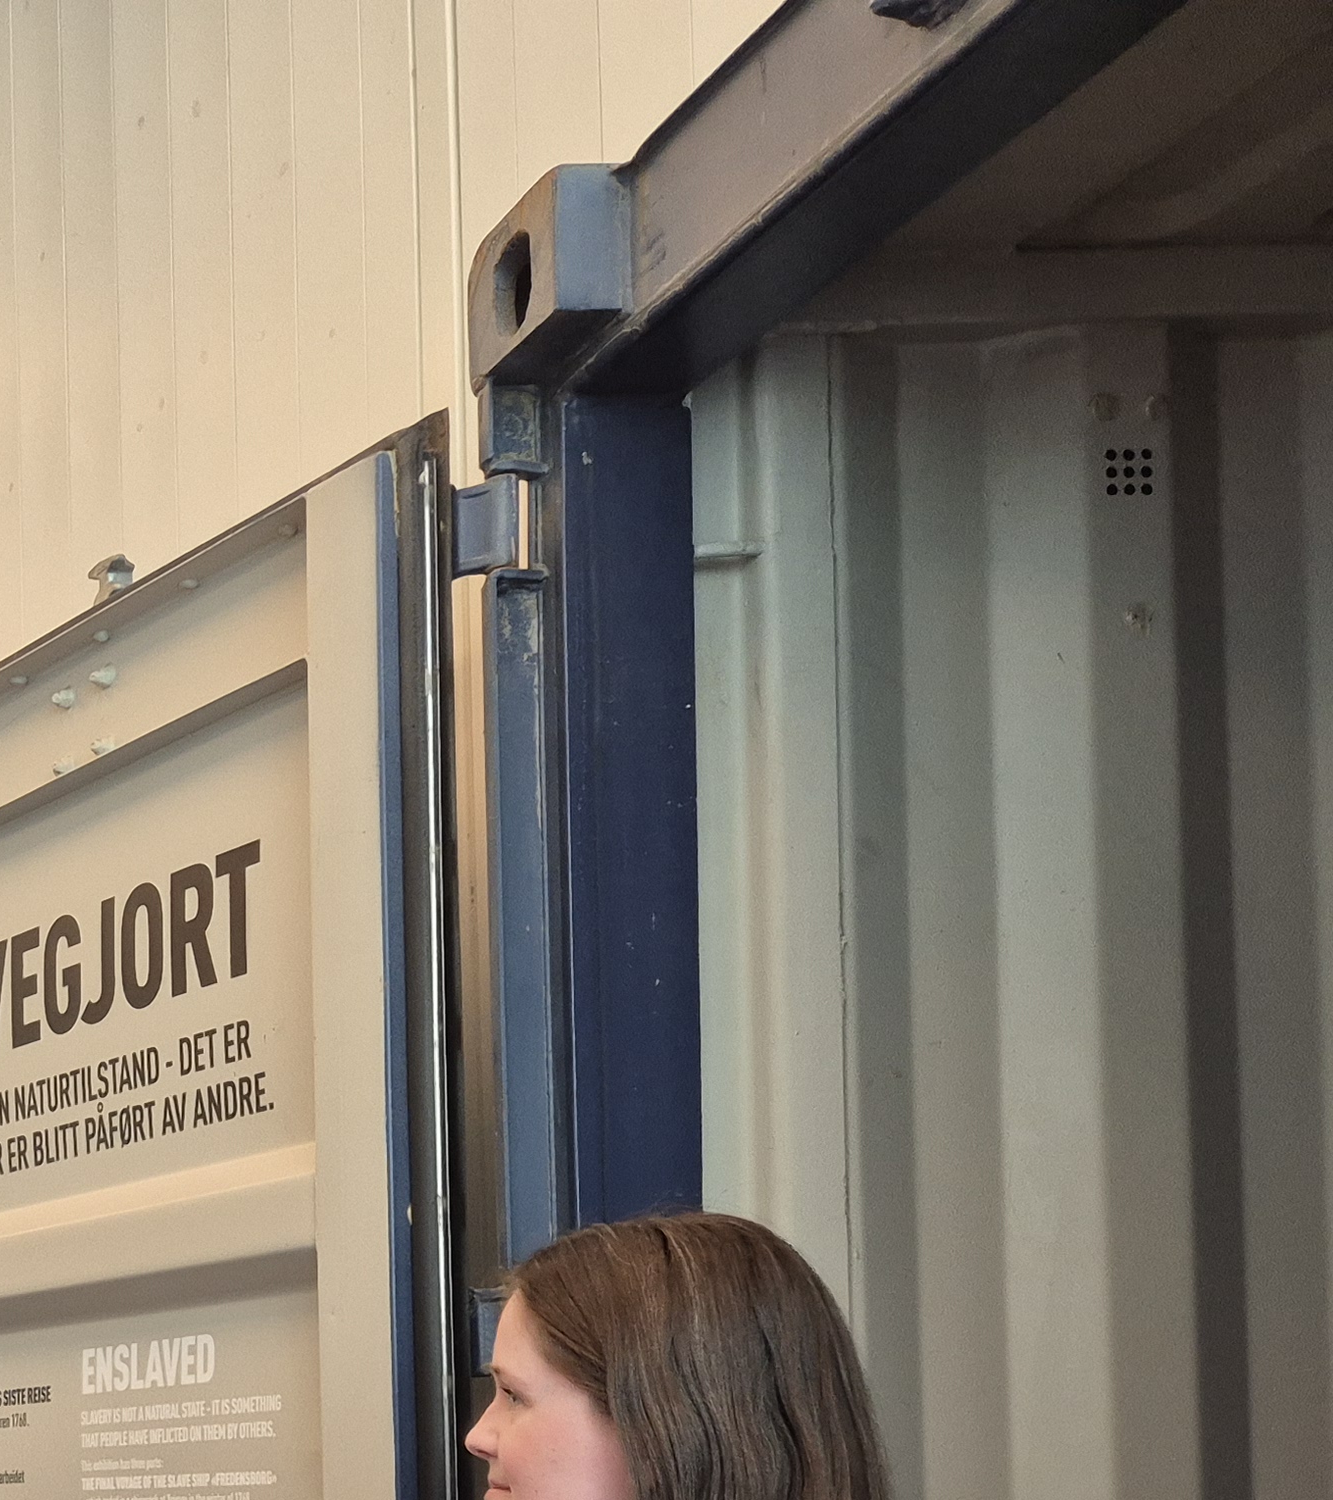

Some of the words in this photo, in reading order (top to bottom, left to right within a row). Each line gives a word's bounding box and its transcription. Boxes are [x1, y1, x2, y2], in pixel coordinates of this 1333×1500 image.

[14, 1053, 160, 1124] NATURTILSTAND
[179, 1028, 216, 1076] DET
[223, 1019, 252, 1064] ER
[8, 1138, 29, 1174] ER
[33, 1121, 80, 1167] BLITT
[85, 1102, 156, 1156] PÅFØRT
[161, 1092, 189, 1135] AV
[193, 1072, 275, 1128] ANDRE.
[82, 1333, 215, 1394] ENSLAVED
[3, 1388, 26, 1407] SISTE
[27, 1385, 52, 1404] REISE
[80, 1409, 112, 1425] SLAVERY
[113, 1408, 121, 1423] IS
[122, 1406, 138, 1422] NOT
[138, 1406, 145, 1420] A
[145, 1402, 181, 1420] NATURAL
[181, 1400, 206, 1418] STATE
[212, 1399, 220, 1415] IT
[221, 1399, 230, 1414] IS
[231, 1394, 282, 1414] SOMETHING
[81, 1433, 99, 1448] THAT
[100, 1430, 128, 1446] PEOPLE
[129, 1428, 148, 1445] HAVE
[149, 1425, 188, 1444] INFLICTED
[189, 1425, 202, 1441] ON
[203, 1423, 226, 1440] THEM
[227, 1422, 239, 1439] BY
[239, 1420, 277, 1438] OTHERS.
